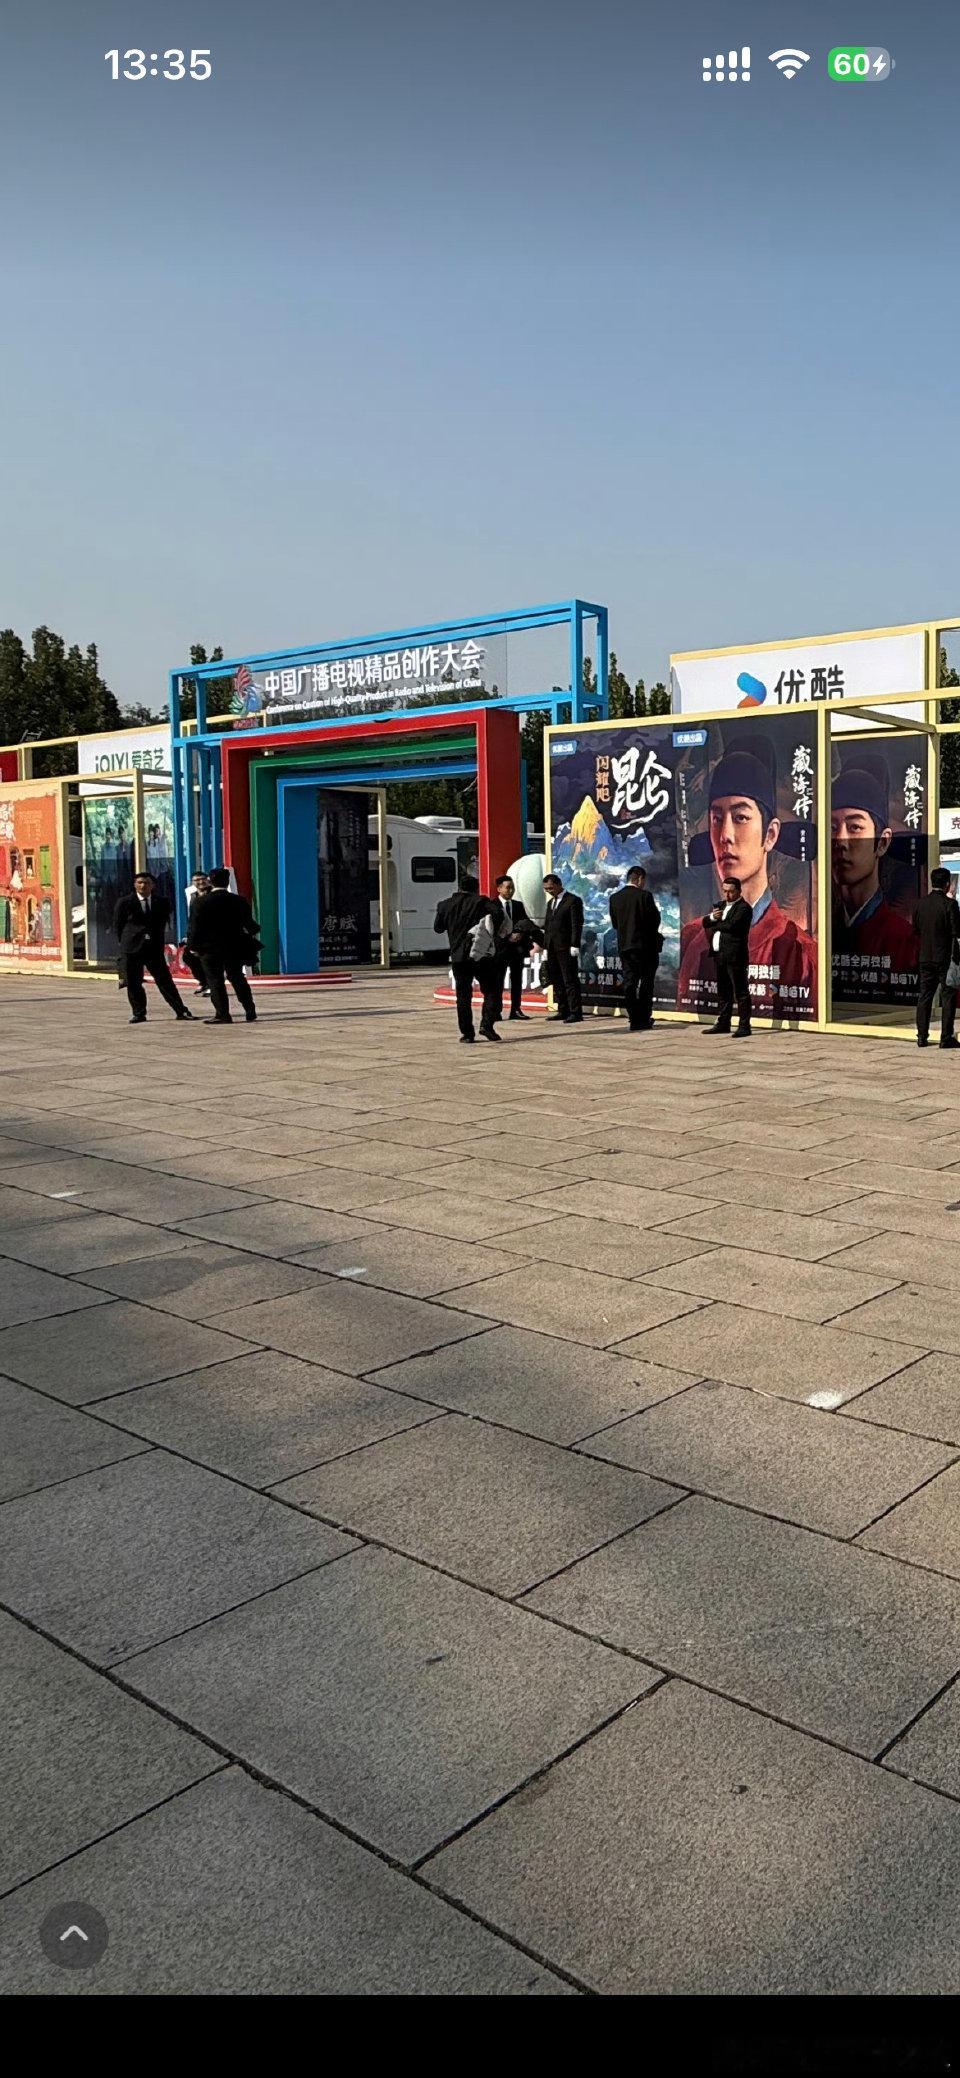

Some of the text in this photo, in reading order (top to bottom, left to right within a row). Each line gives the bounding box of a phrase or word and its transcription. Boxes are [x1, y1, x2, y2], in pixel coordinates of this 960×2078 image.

[265, 640, 481, 699] 中国广播电视精品创作大会
[463, 677, 482, 688] China
[774, 664, 845, 704] 优酷
[95, 748, 164, 773] iQIYI 爱奇艺
[595, 755, 612, 802] 闪耀吧
[791, 745, 815, 819] 藏海传
[611, 747, 673, 829] 昆仑
[903, 764, 924, 829] 藏海传
[747, 964, 781, 980] 网独播
[779, 984, 811, 999] 酷喵TV
